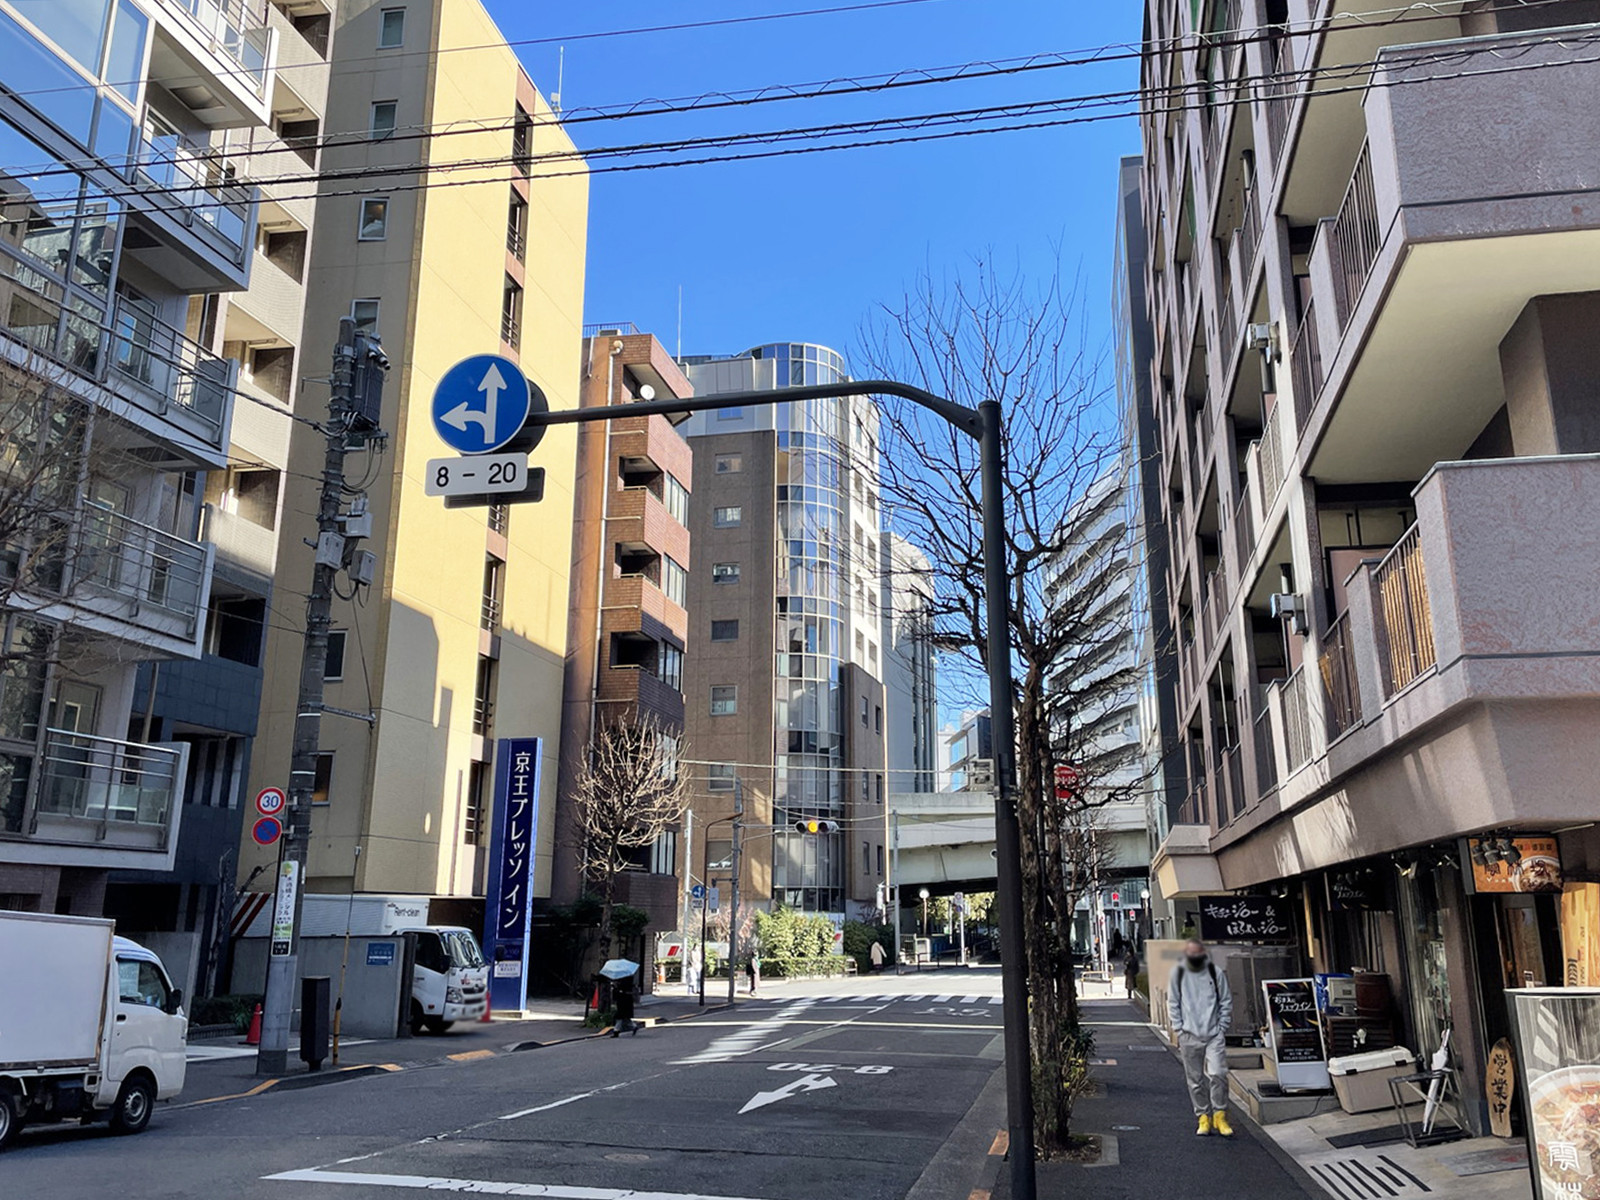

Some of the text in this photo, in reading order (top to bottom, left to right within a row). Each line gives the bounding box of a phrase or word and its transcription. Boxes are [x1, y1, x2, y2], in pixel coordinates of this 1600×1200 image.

[436, 466, 449, 488] 8
[488, 462, 517, 485] 20
[262, 795, 279, 808] 30
[503, 751, 532, 929] 京王プレッソイン
[1265, 905, 1275, 916] &
[1491, 1053, 1508, 1123] 営業中
